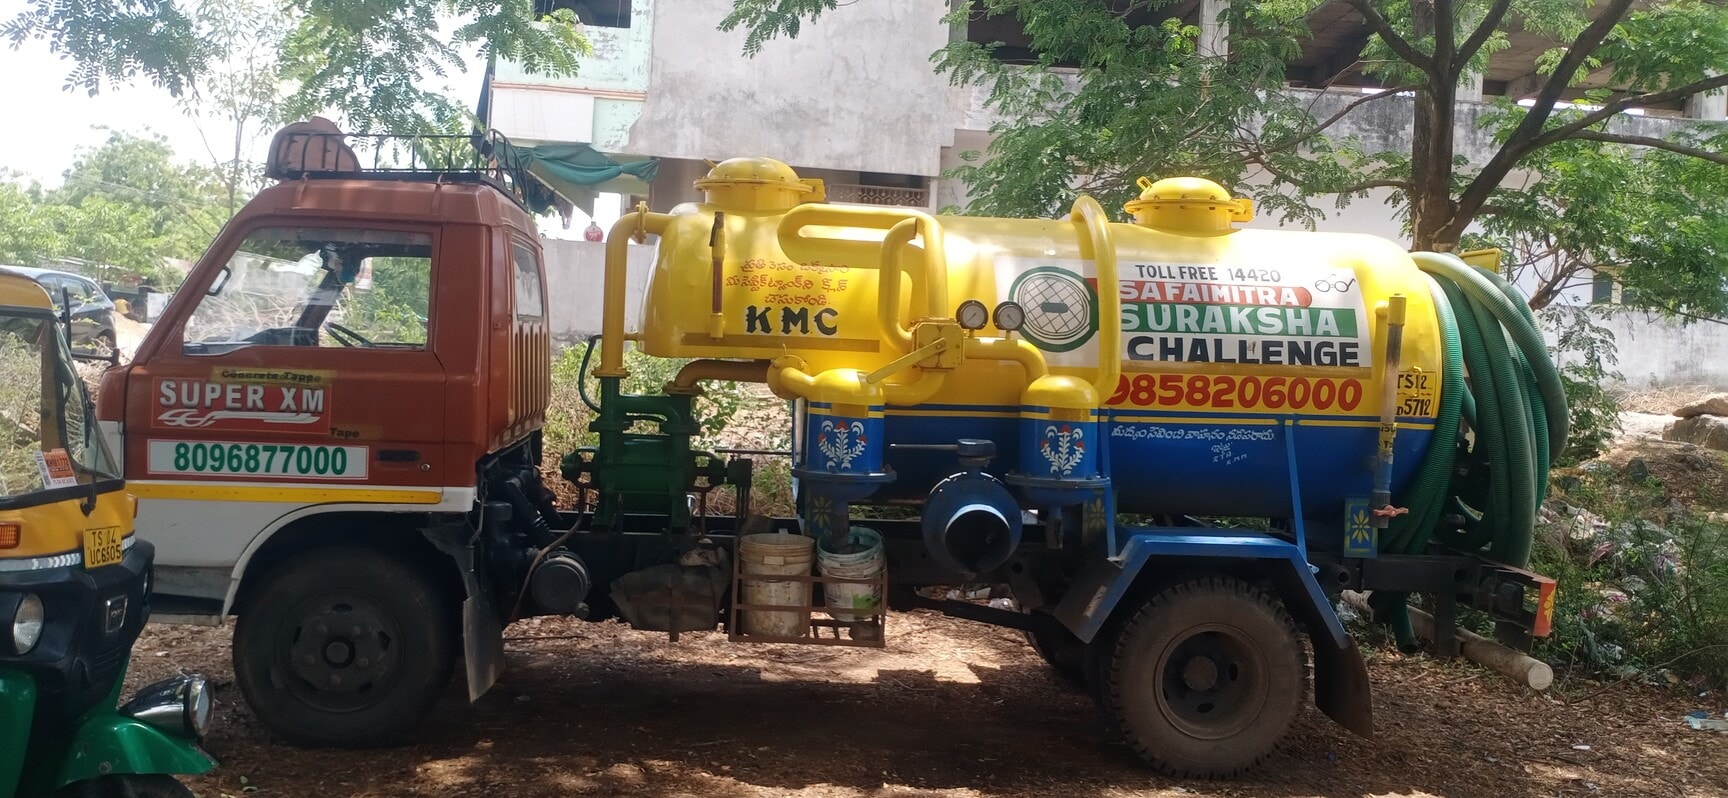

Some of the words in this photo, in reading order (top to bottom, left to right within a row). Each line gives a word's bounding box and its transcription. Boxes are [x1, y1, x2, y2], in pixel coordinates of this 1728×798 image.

[1135, 264, 1176, 280] TOLL
[1179, 266, 1219, 281] FREE
[1227, 267, 1281, 283] 14420
[1119, 280, 1299, 307] SAFAIMITRA
[1120, 303, 1340, 337] SURAKSHA
[1127, 335, 1360, 367] CHALLENGE
[159, 379, 266, 411] SUPER
[279, 386, 324, 413] XM
[329, 427, 360, 439] Tape
[174, 442, 347, 475] 8096877000
[92, 530, 103, 547] TS
[107, 529, 117, 544] 04
